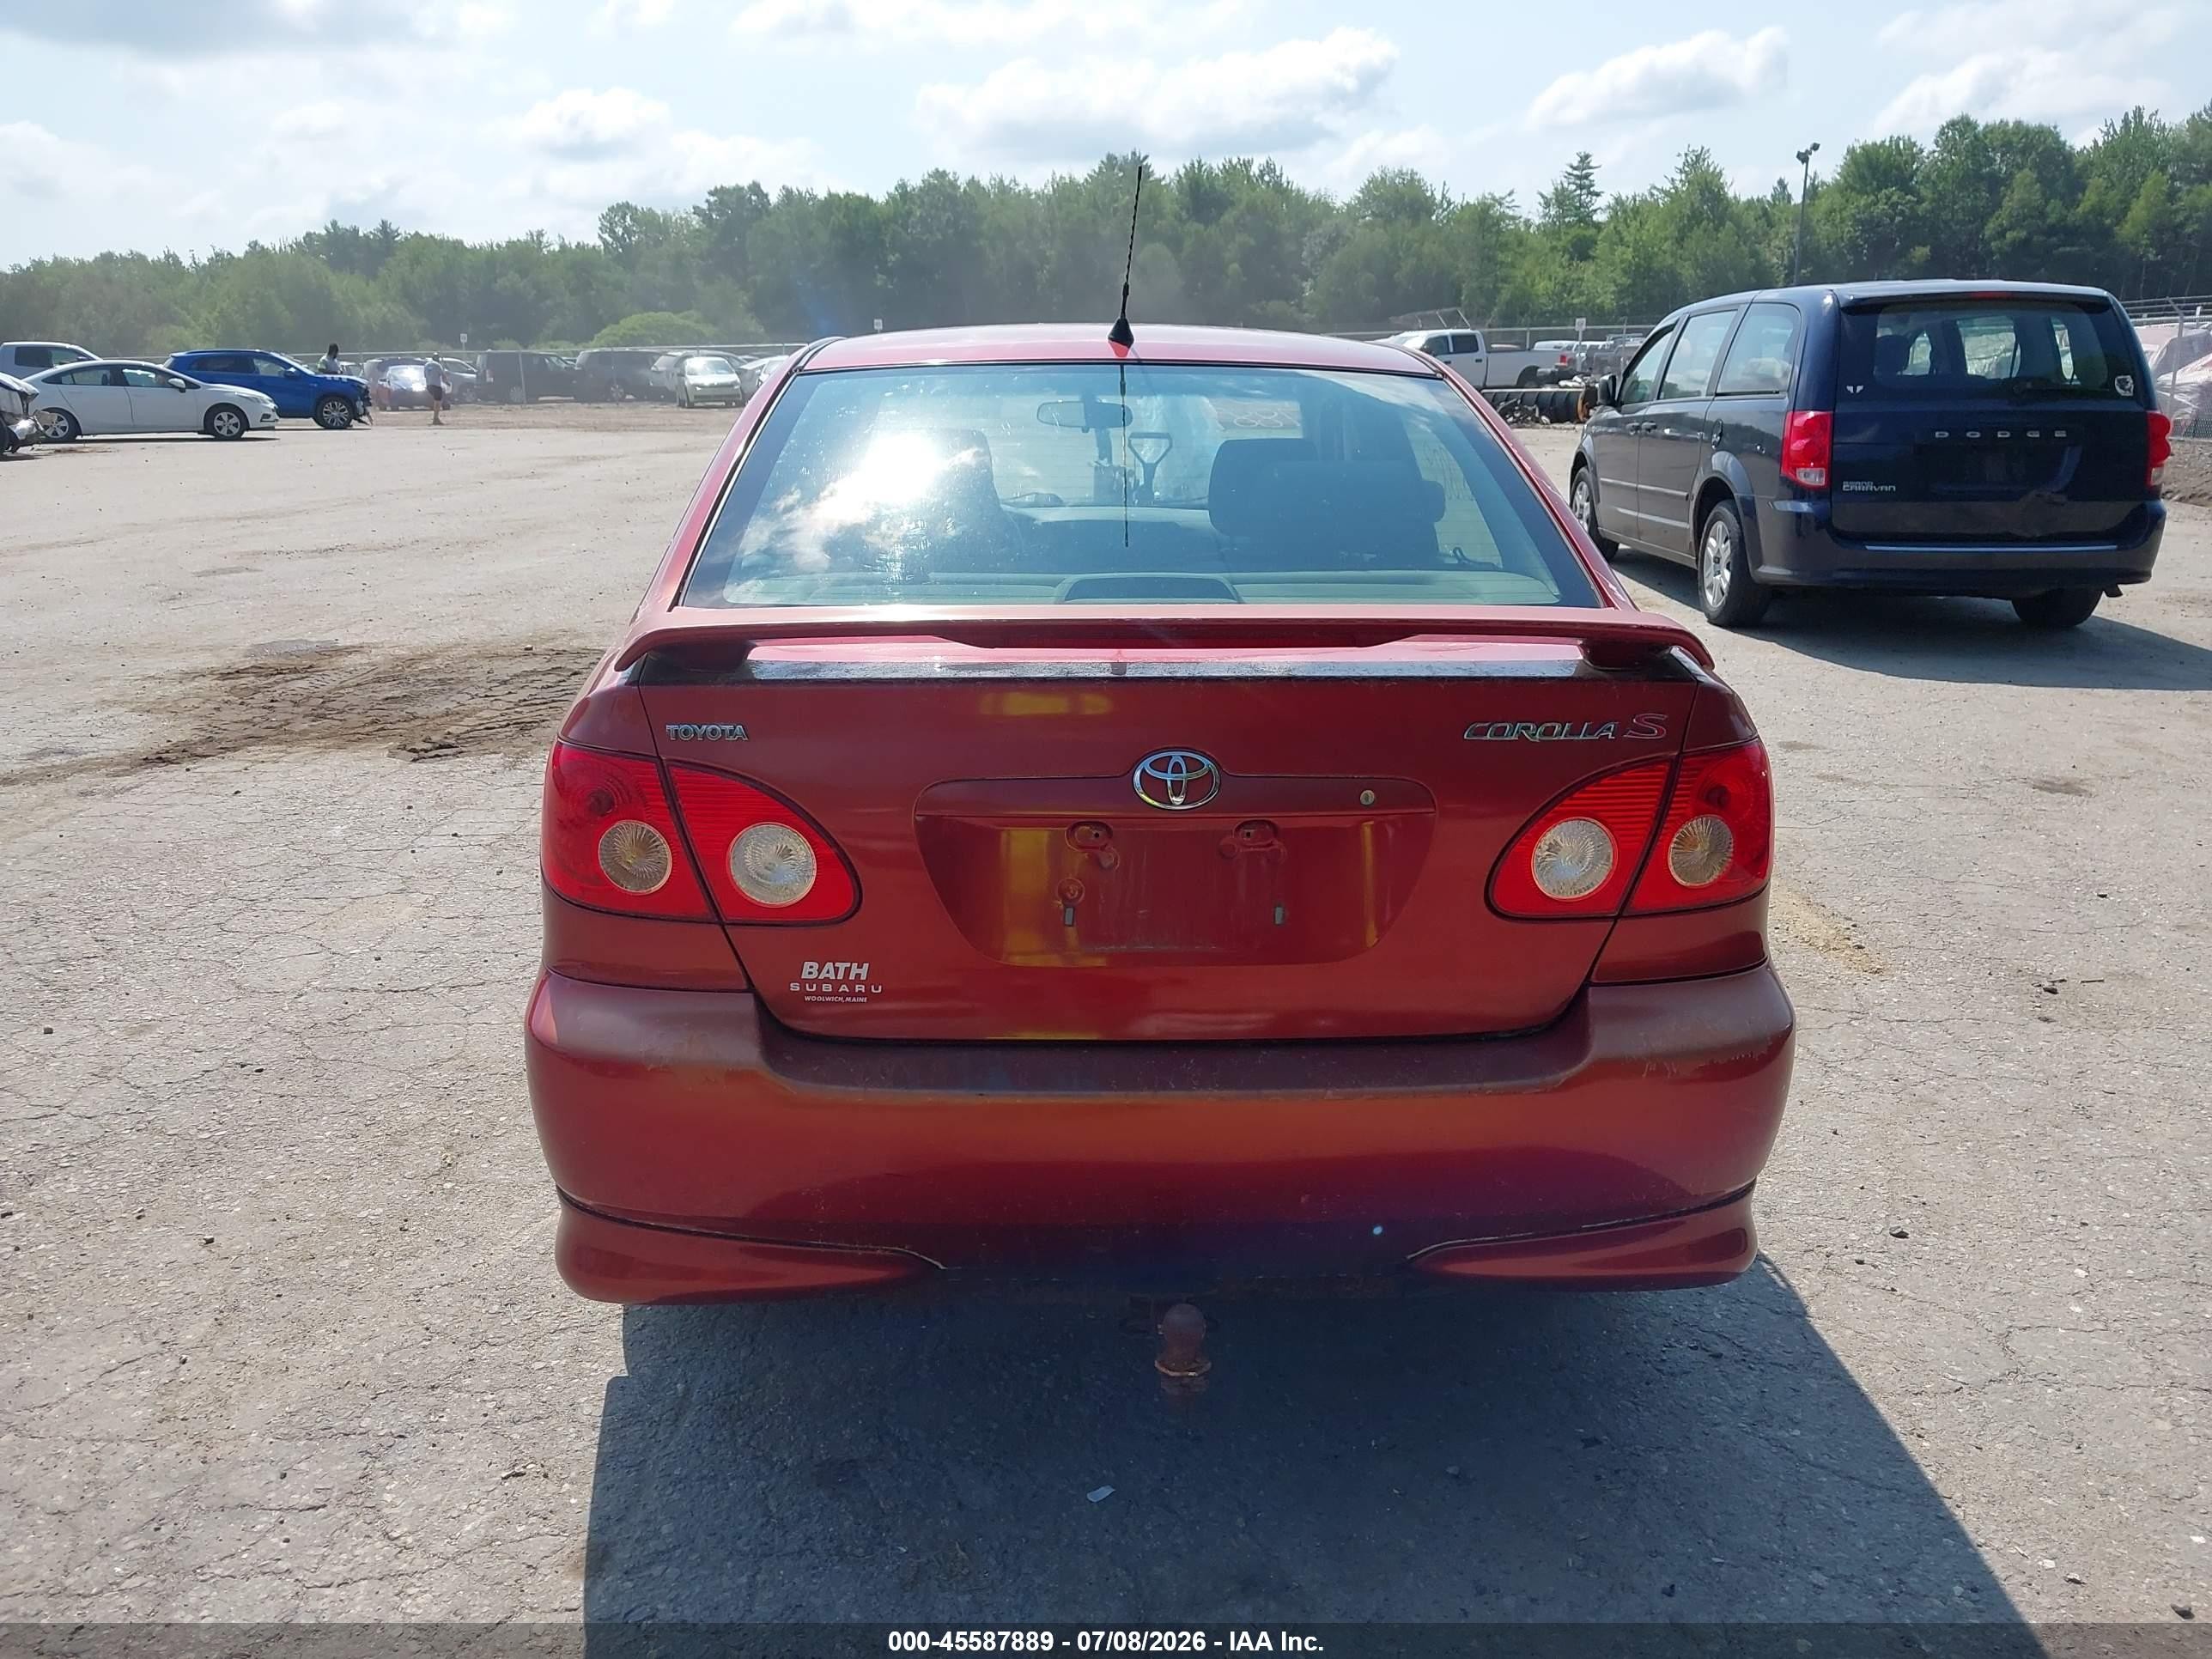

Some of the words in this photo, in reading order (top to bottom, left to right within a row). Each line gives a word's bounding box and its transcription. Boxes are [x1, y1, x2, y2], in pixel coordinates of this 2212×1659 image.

[665, 724, 749, 741] TOYOTA
[1463, 721, 1620, 742] COROLLA
[1623, 713, 1668, 739] S
[801, 961, 870, 981] BATH
[789, 982, 883, 994] SUBARU
